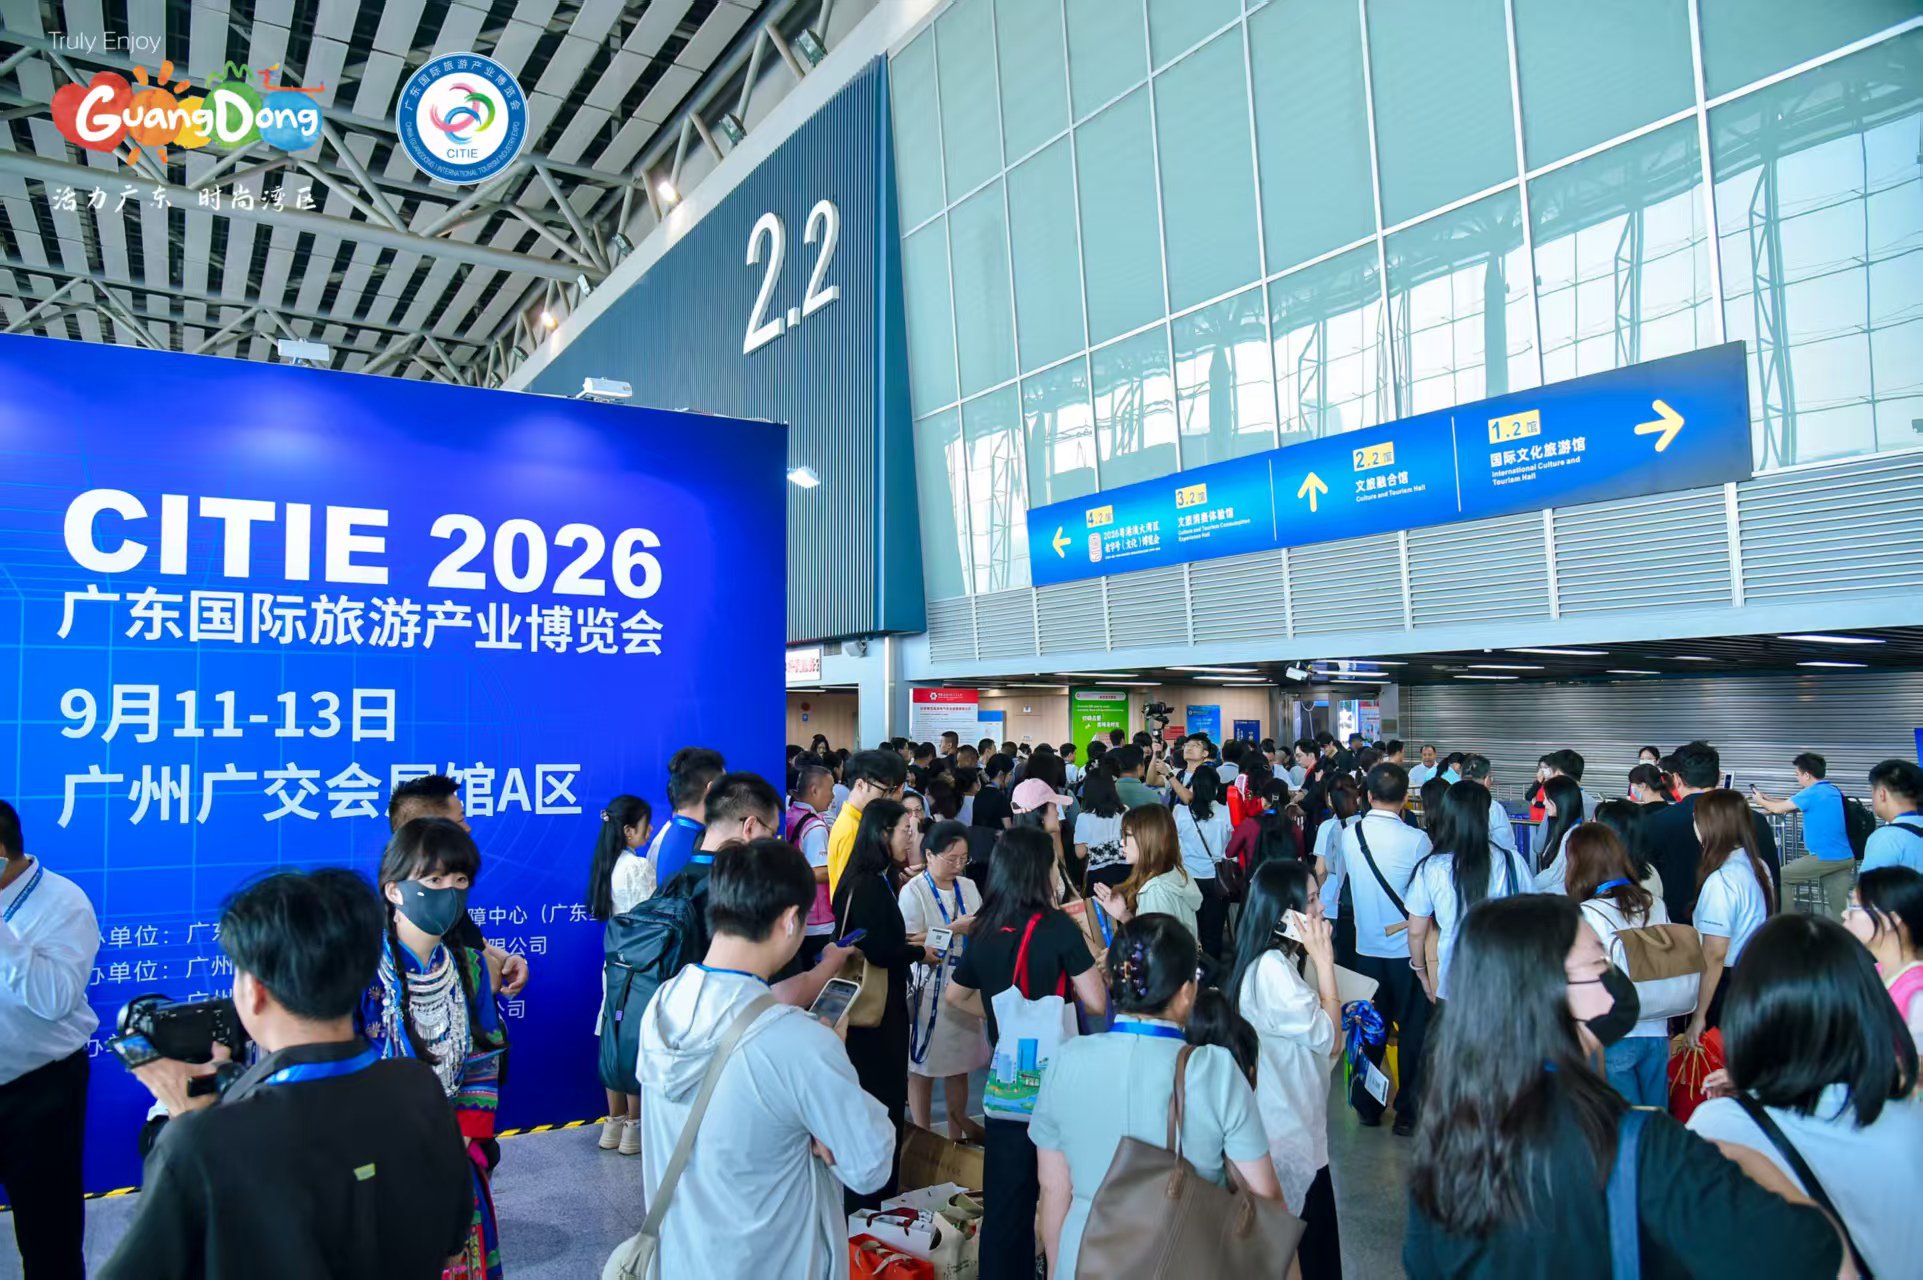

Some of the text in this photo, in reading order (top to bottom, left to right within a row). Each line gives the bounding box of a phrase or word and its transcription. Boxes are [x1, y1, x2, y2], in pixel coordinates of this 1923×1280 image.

[743, 199, 840, 356] 2.2
[1490, 436, 1586, 468] 国际文化旅游馆
[1491, 455, 1581, 478] International Culture and
[1355, 471, 1409, 493] 文旅融合馆
[1355, 494, 1377, 502] Culture
[1389, 487, 1413, 496] Tourism
[1413, 483, 1426, 491] Hall
[1492, 472, 1536, 486] Tourism Hall
[63, 488, 662, 599] CITIE 2026
[57, 584, 664, 656] 广东国际旅游产业博览会
[60, 683, 397, 744] 9月11-13日
